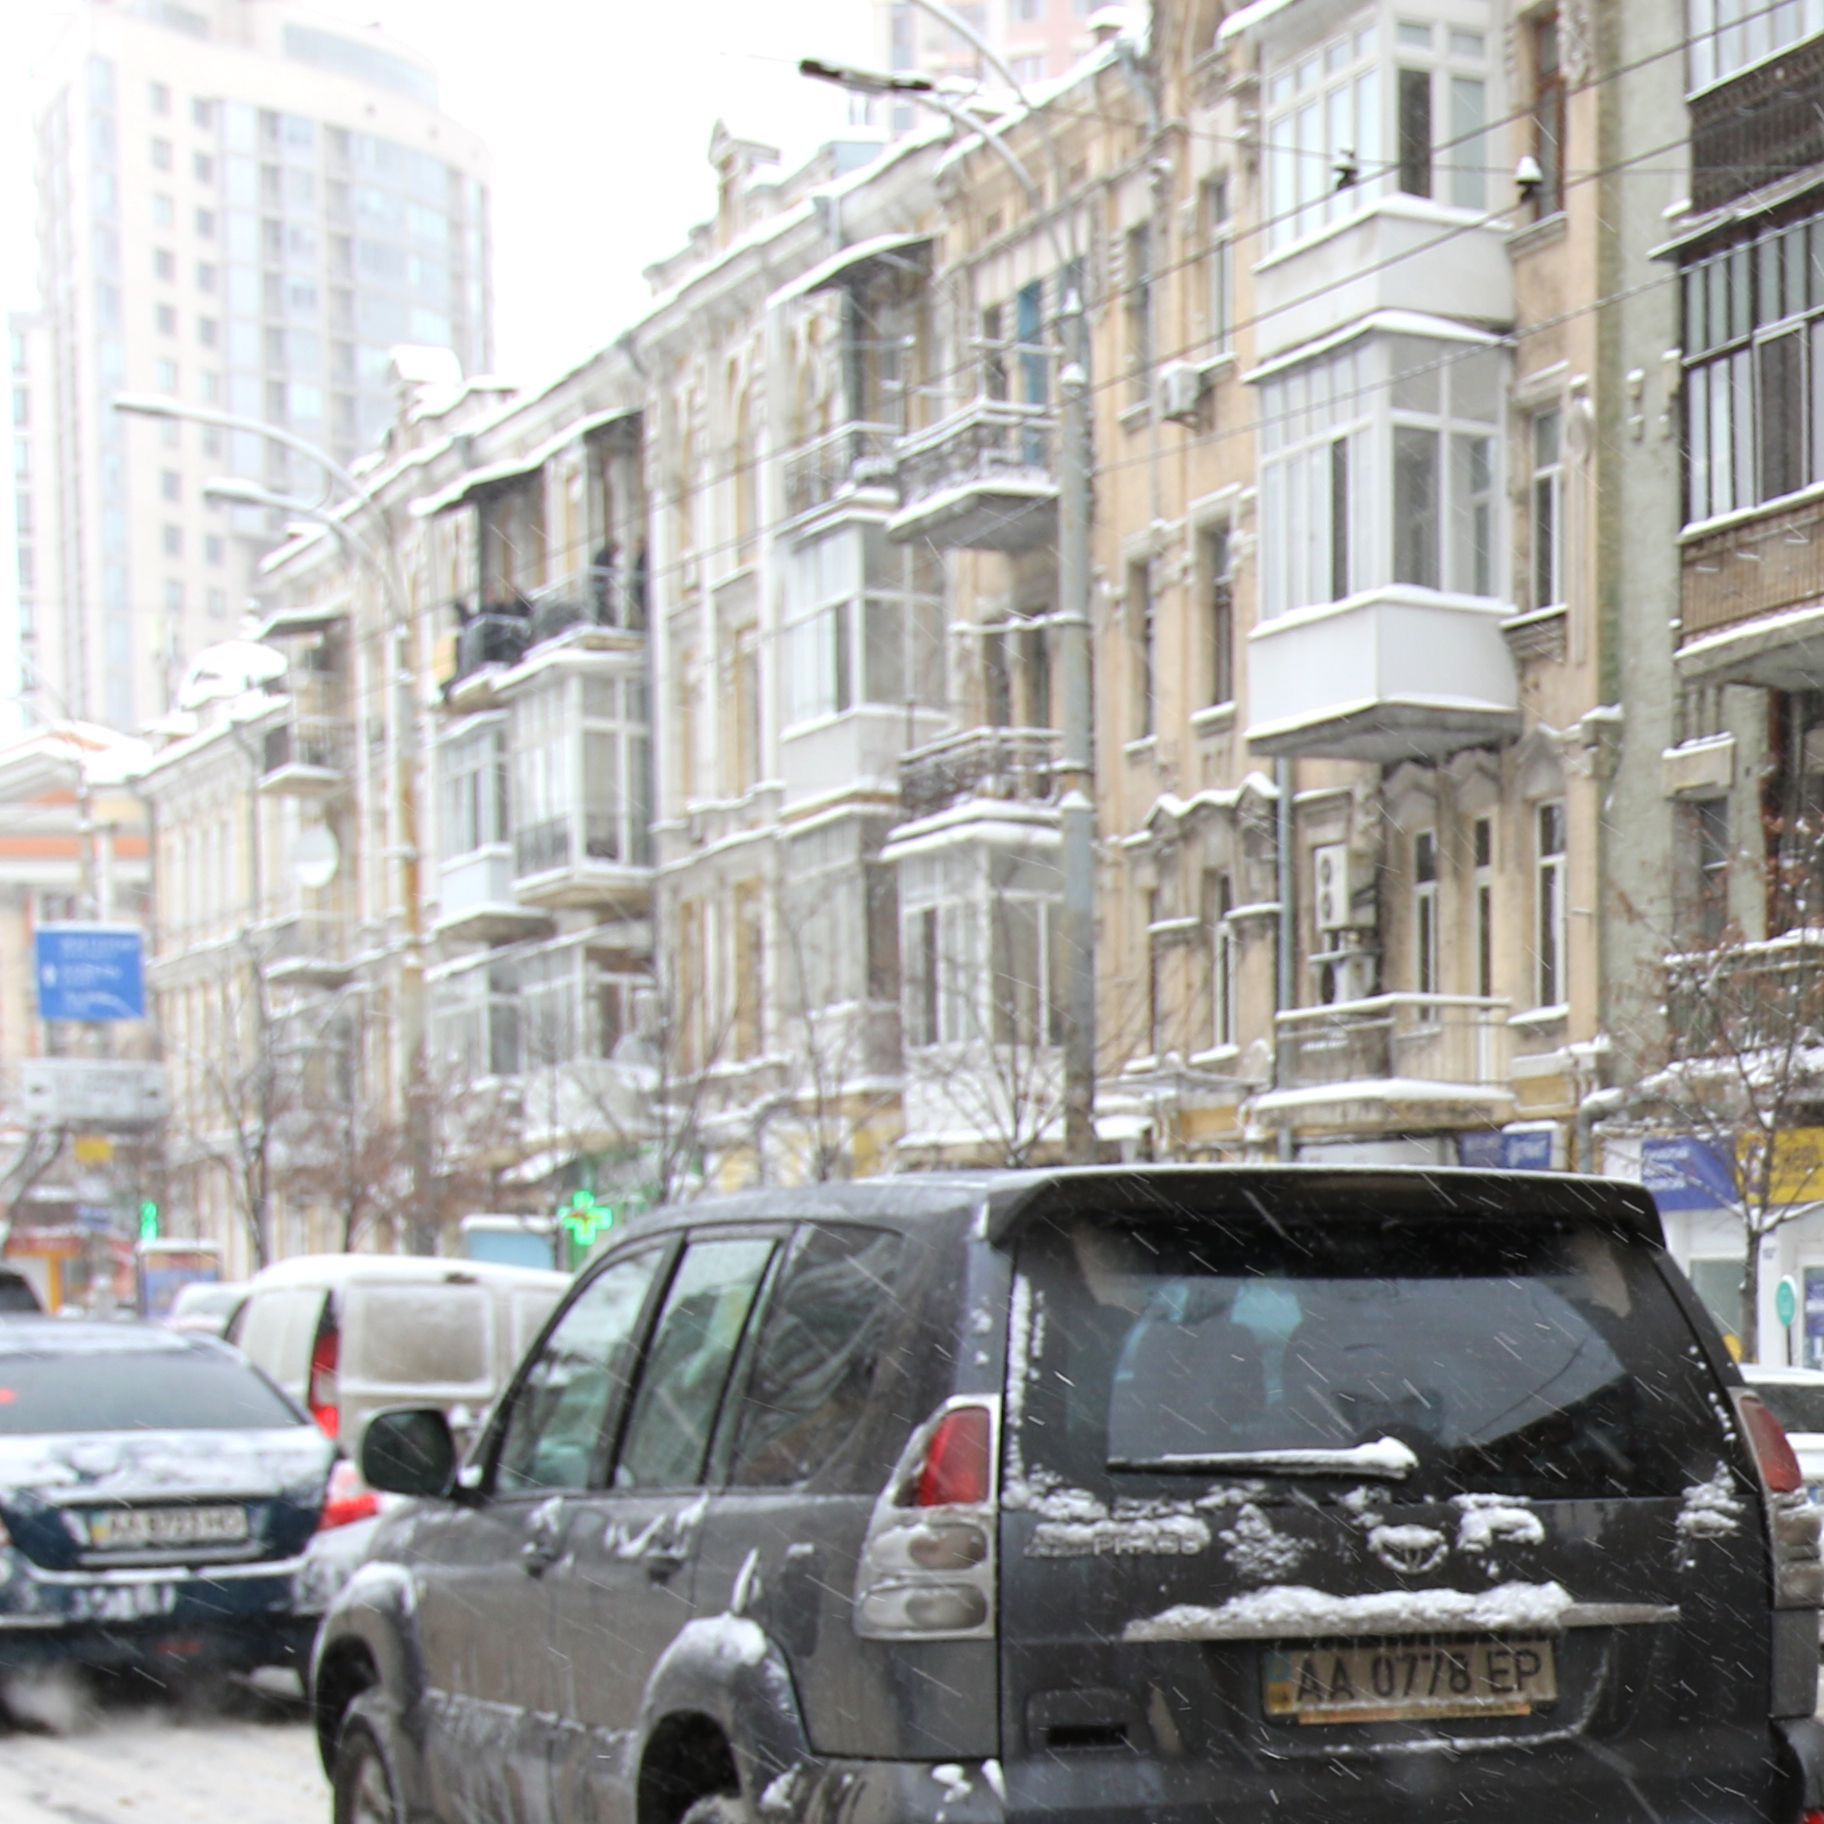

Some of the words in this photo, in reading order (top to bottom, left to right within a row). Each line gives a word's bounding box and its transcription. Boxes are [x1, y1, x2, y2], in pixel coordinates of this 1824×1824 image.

[1297, 1654, 1354, 1700] AA
[1370, 1652, 1472, 1698] 0778
[1486, 1649, 1542, 1694] EP
